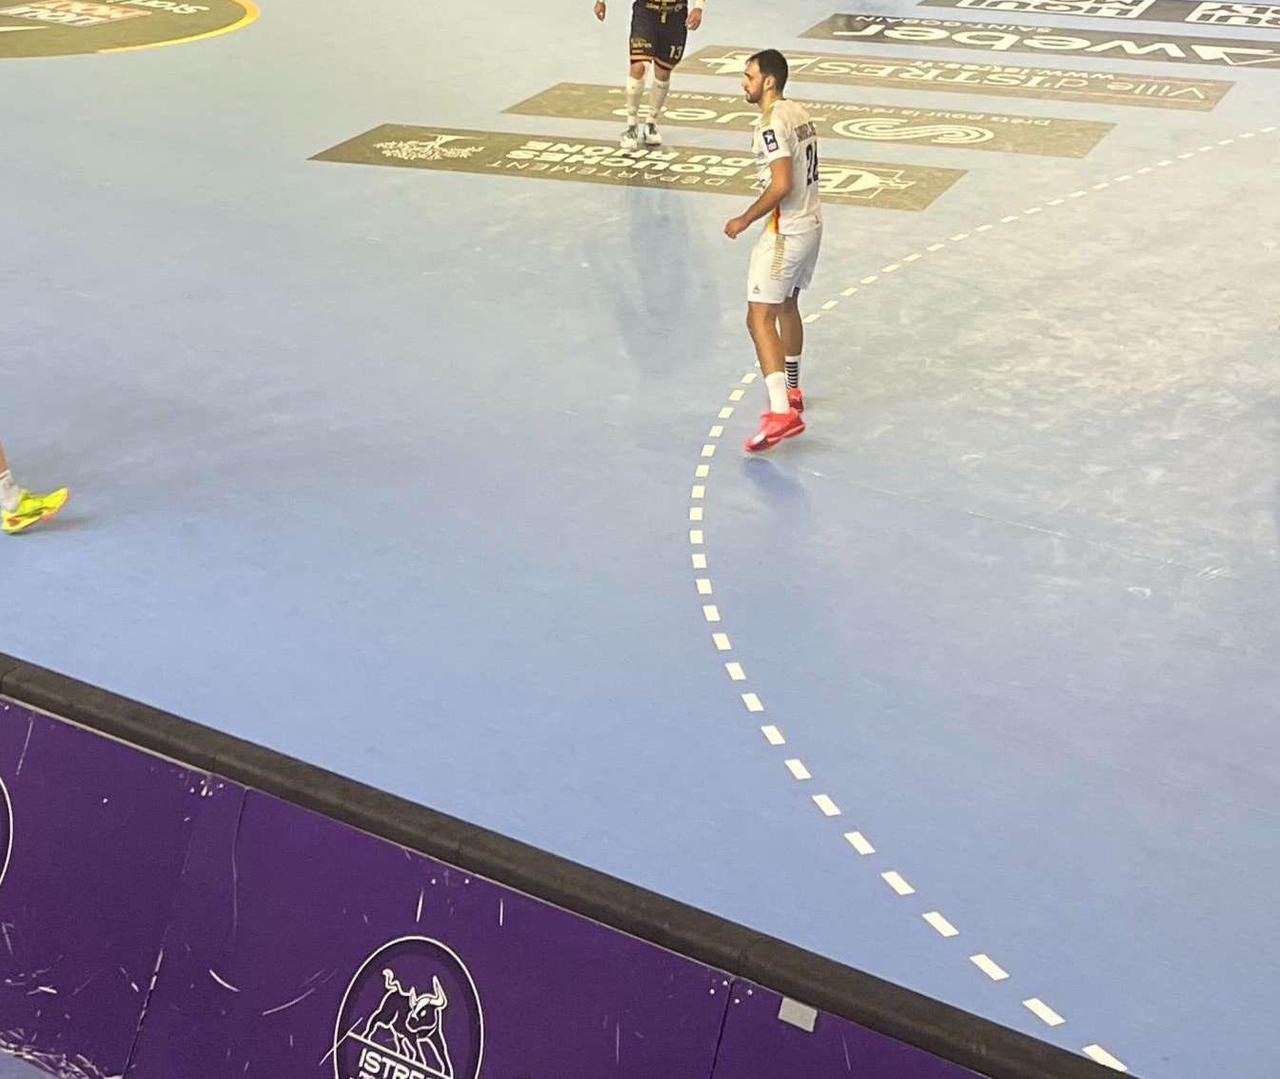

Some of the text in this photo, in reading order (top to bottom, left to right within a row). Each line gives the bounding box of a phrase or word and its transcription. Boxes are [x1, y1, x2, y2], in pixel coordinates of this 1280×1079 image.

[669, 44, 683, 59] 13
[830, 23, 1187, 59] weber
[813, 60, 1207, 100] Ville d'ISTRES
[612, 104, 782, 126] uez
[506, 149, 746, 176] BOUCHES
[689, 154, 757, 169] DU
[358, 1048, 434, 1079] ISTRE
